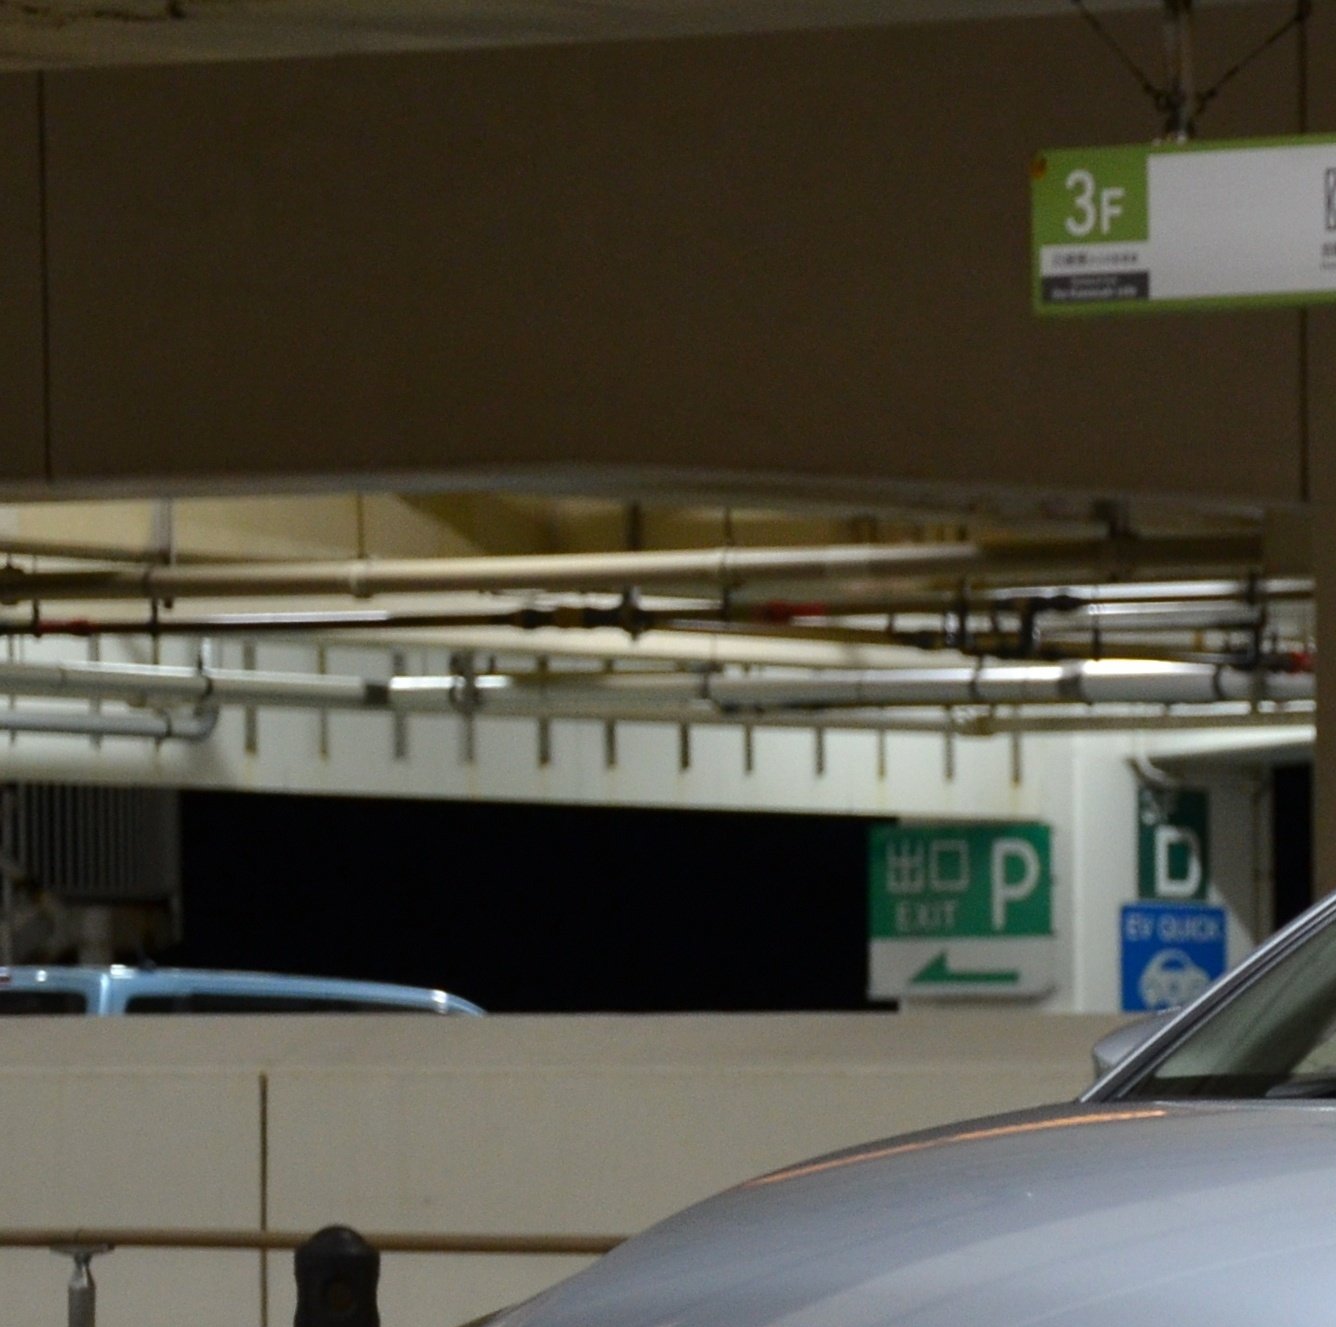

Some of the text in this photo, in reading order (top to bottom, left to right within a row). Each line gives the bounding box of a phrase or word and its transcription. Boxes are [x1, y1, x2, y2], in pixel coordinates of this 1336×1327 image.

[1064, 169, 1126, 236] 3F
[885, 837, 970, 894] 出口
[990, 837, 1040, 931] P
[1153, 824, 1202, 897] D
